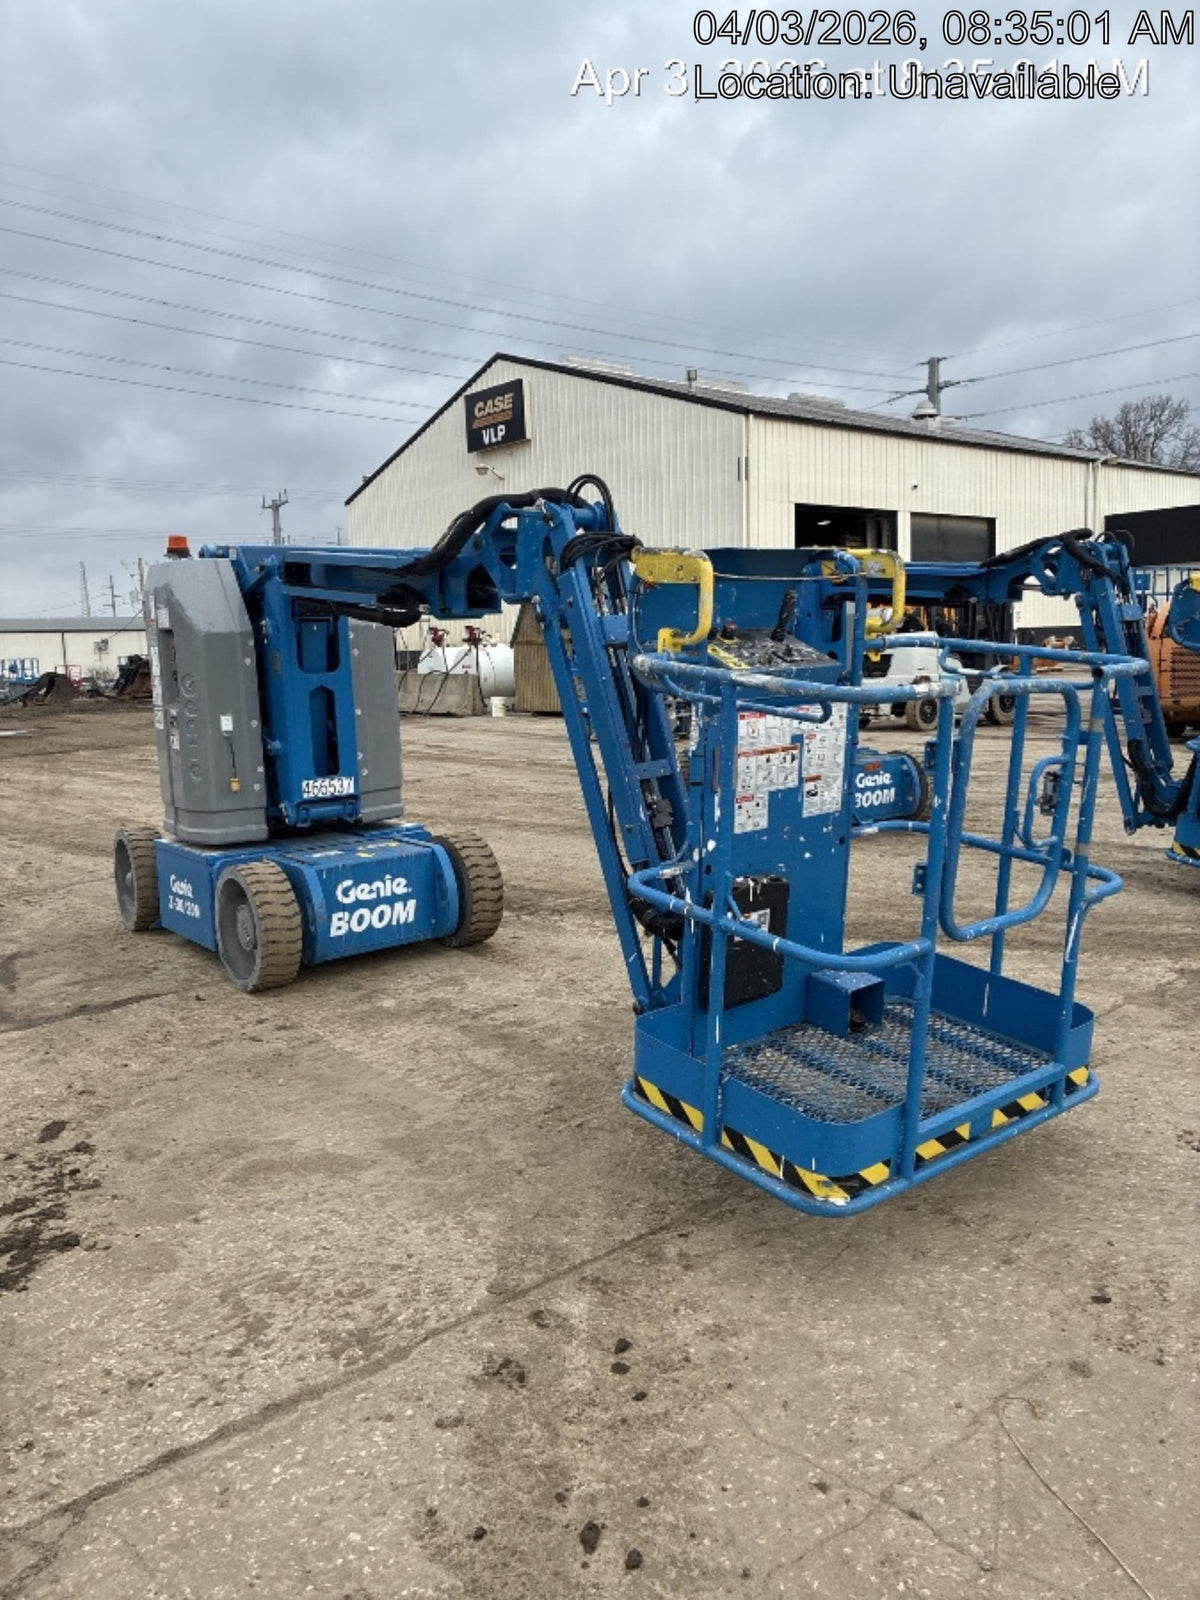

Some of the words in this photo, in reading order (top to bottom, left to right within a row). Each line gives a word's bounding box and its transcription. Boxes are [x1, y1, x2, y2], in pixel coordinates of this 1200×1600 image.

[474, 393, 514, 419] CASE
[482, 424, 506, 445] VLP
[855, 771, 893, 788] Genie
[336, 874, 412, 904] Genie
[330, 899, 417, 937] BOOM
